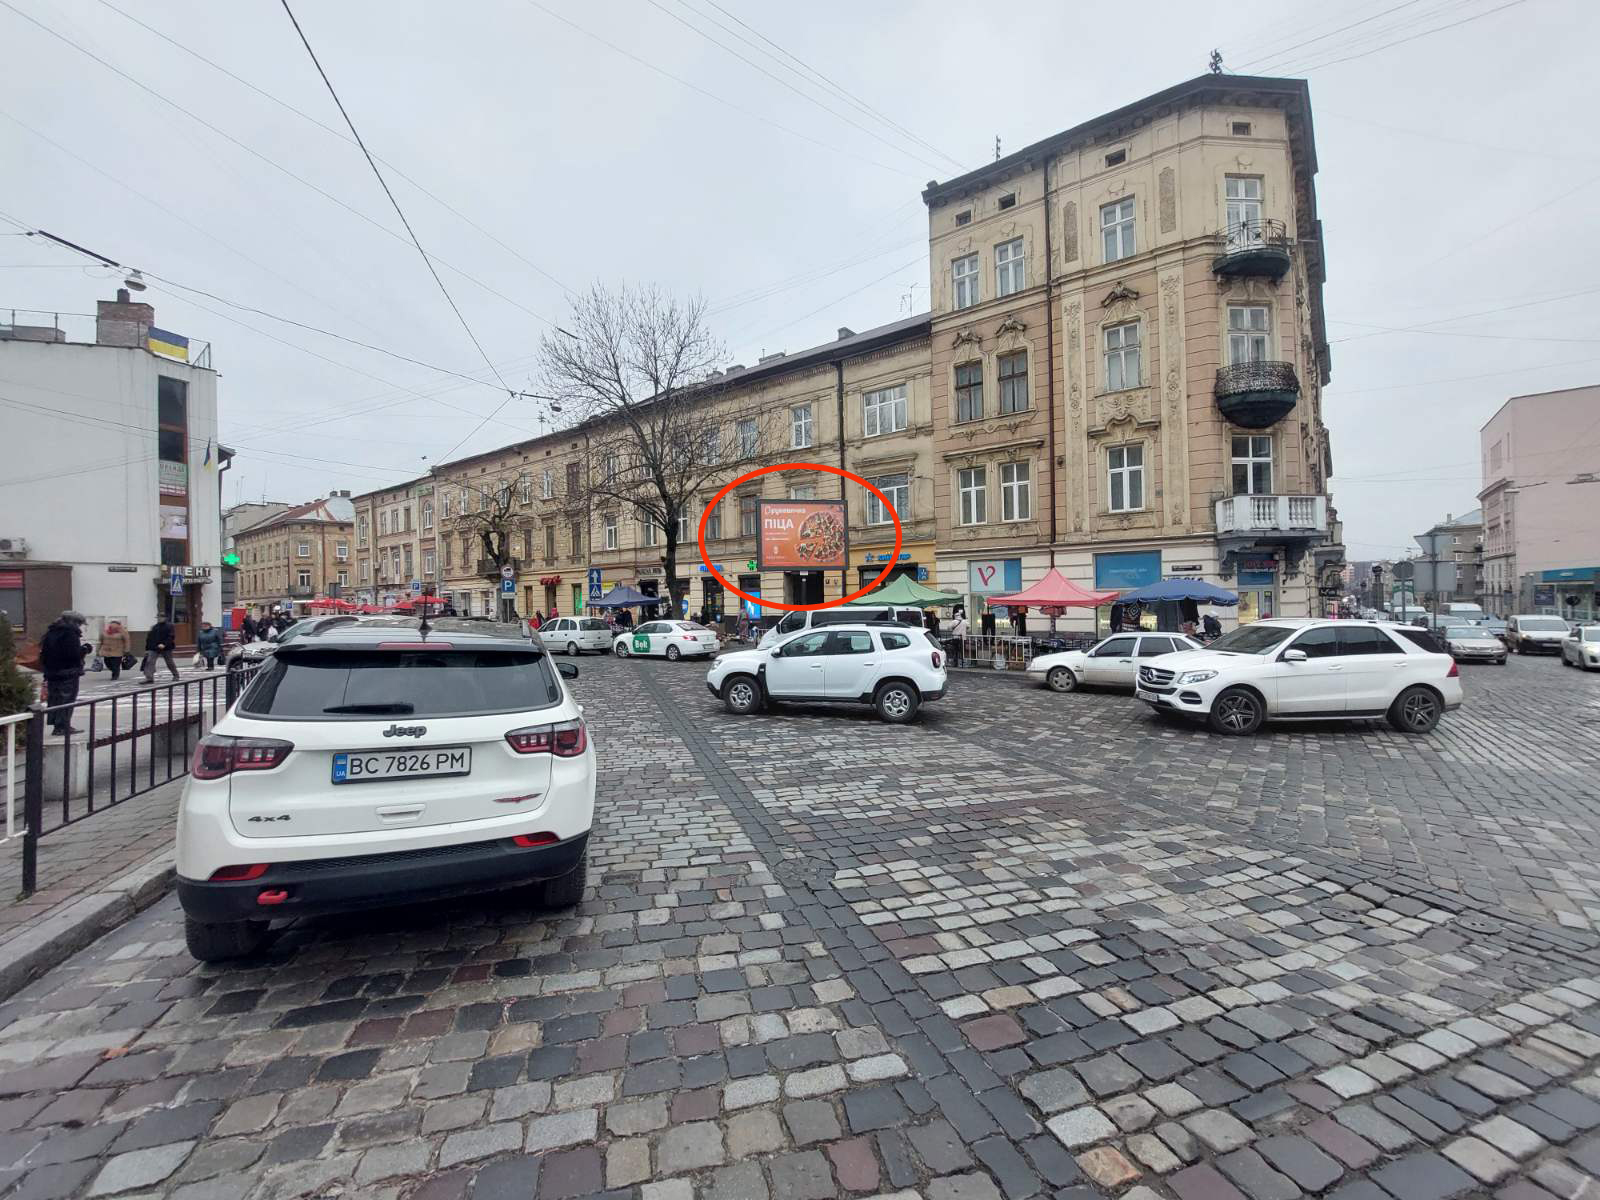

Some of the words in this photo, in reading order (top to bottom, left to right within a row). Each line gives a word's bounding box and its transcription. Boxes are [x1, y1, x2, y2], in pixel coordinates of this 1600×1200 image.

[764, 518, 794, 531] ПІЦА
[635, 639, 648, 649] Bolt
[383, 724, 427, 738] Jeep
[349, 757, 380, 776] BC
[385, 753, 431, 774] 7826
[435, 751, 465, 771] PM
[247, 814, 291, 823] 4x4
